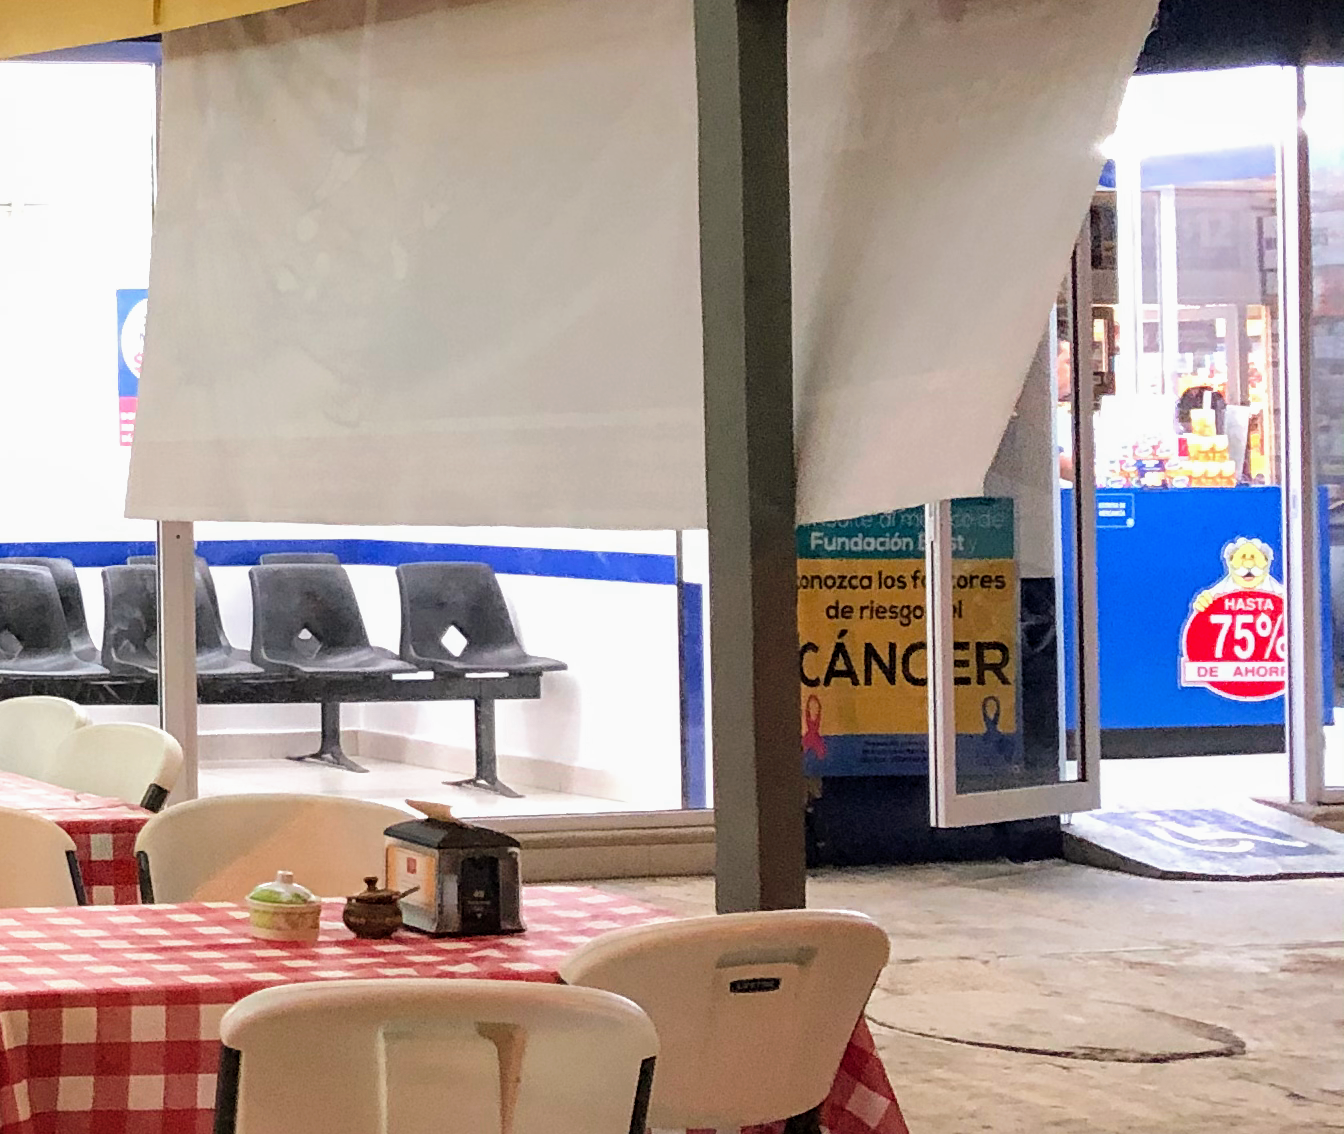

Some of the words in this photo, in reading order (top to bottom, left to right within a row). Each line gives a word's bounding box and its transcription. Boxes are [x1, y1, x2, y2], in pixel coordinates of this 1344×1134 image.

[810, 532, 913, 551] Fundación
[797, 573, 872, 590] onozca
[878, 570, 907, 590] los
[825, 600, 854, 620] de
[859, 600, 925, 627] riesgo
[1224, 598, 1274, 610] HASTA
[1209, 612, 1286, 660] 75%
[1197, 666, 1219, 677] DE
